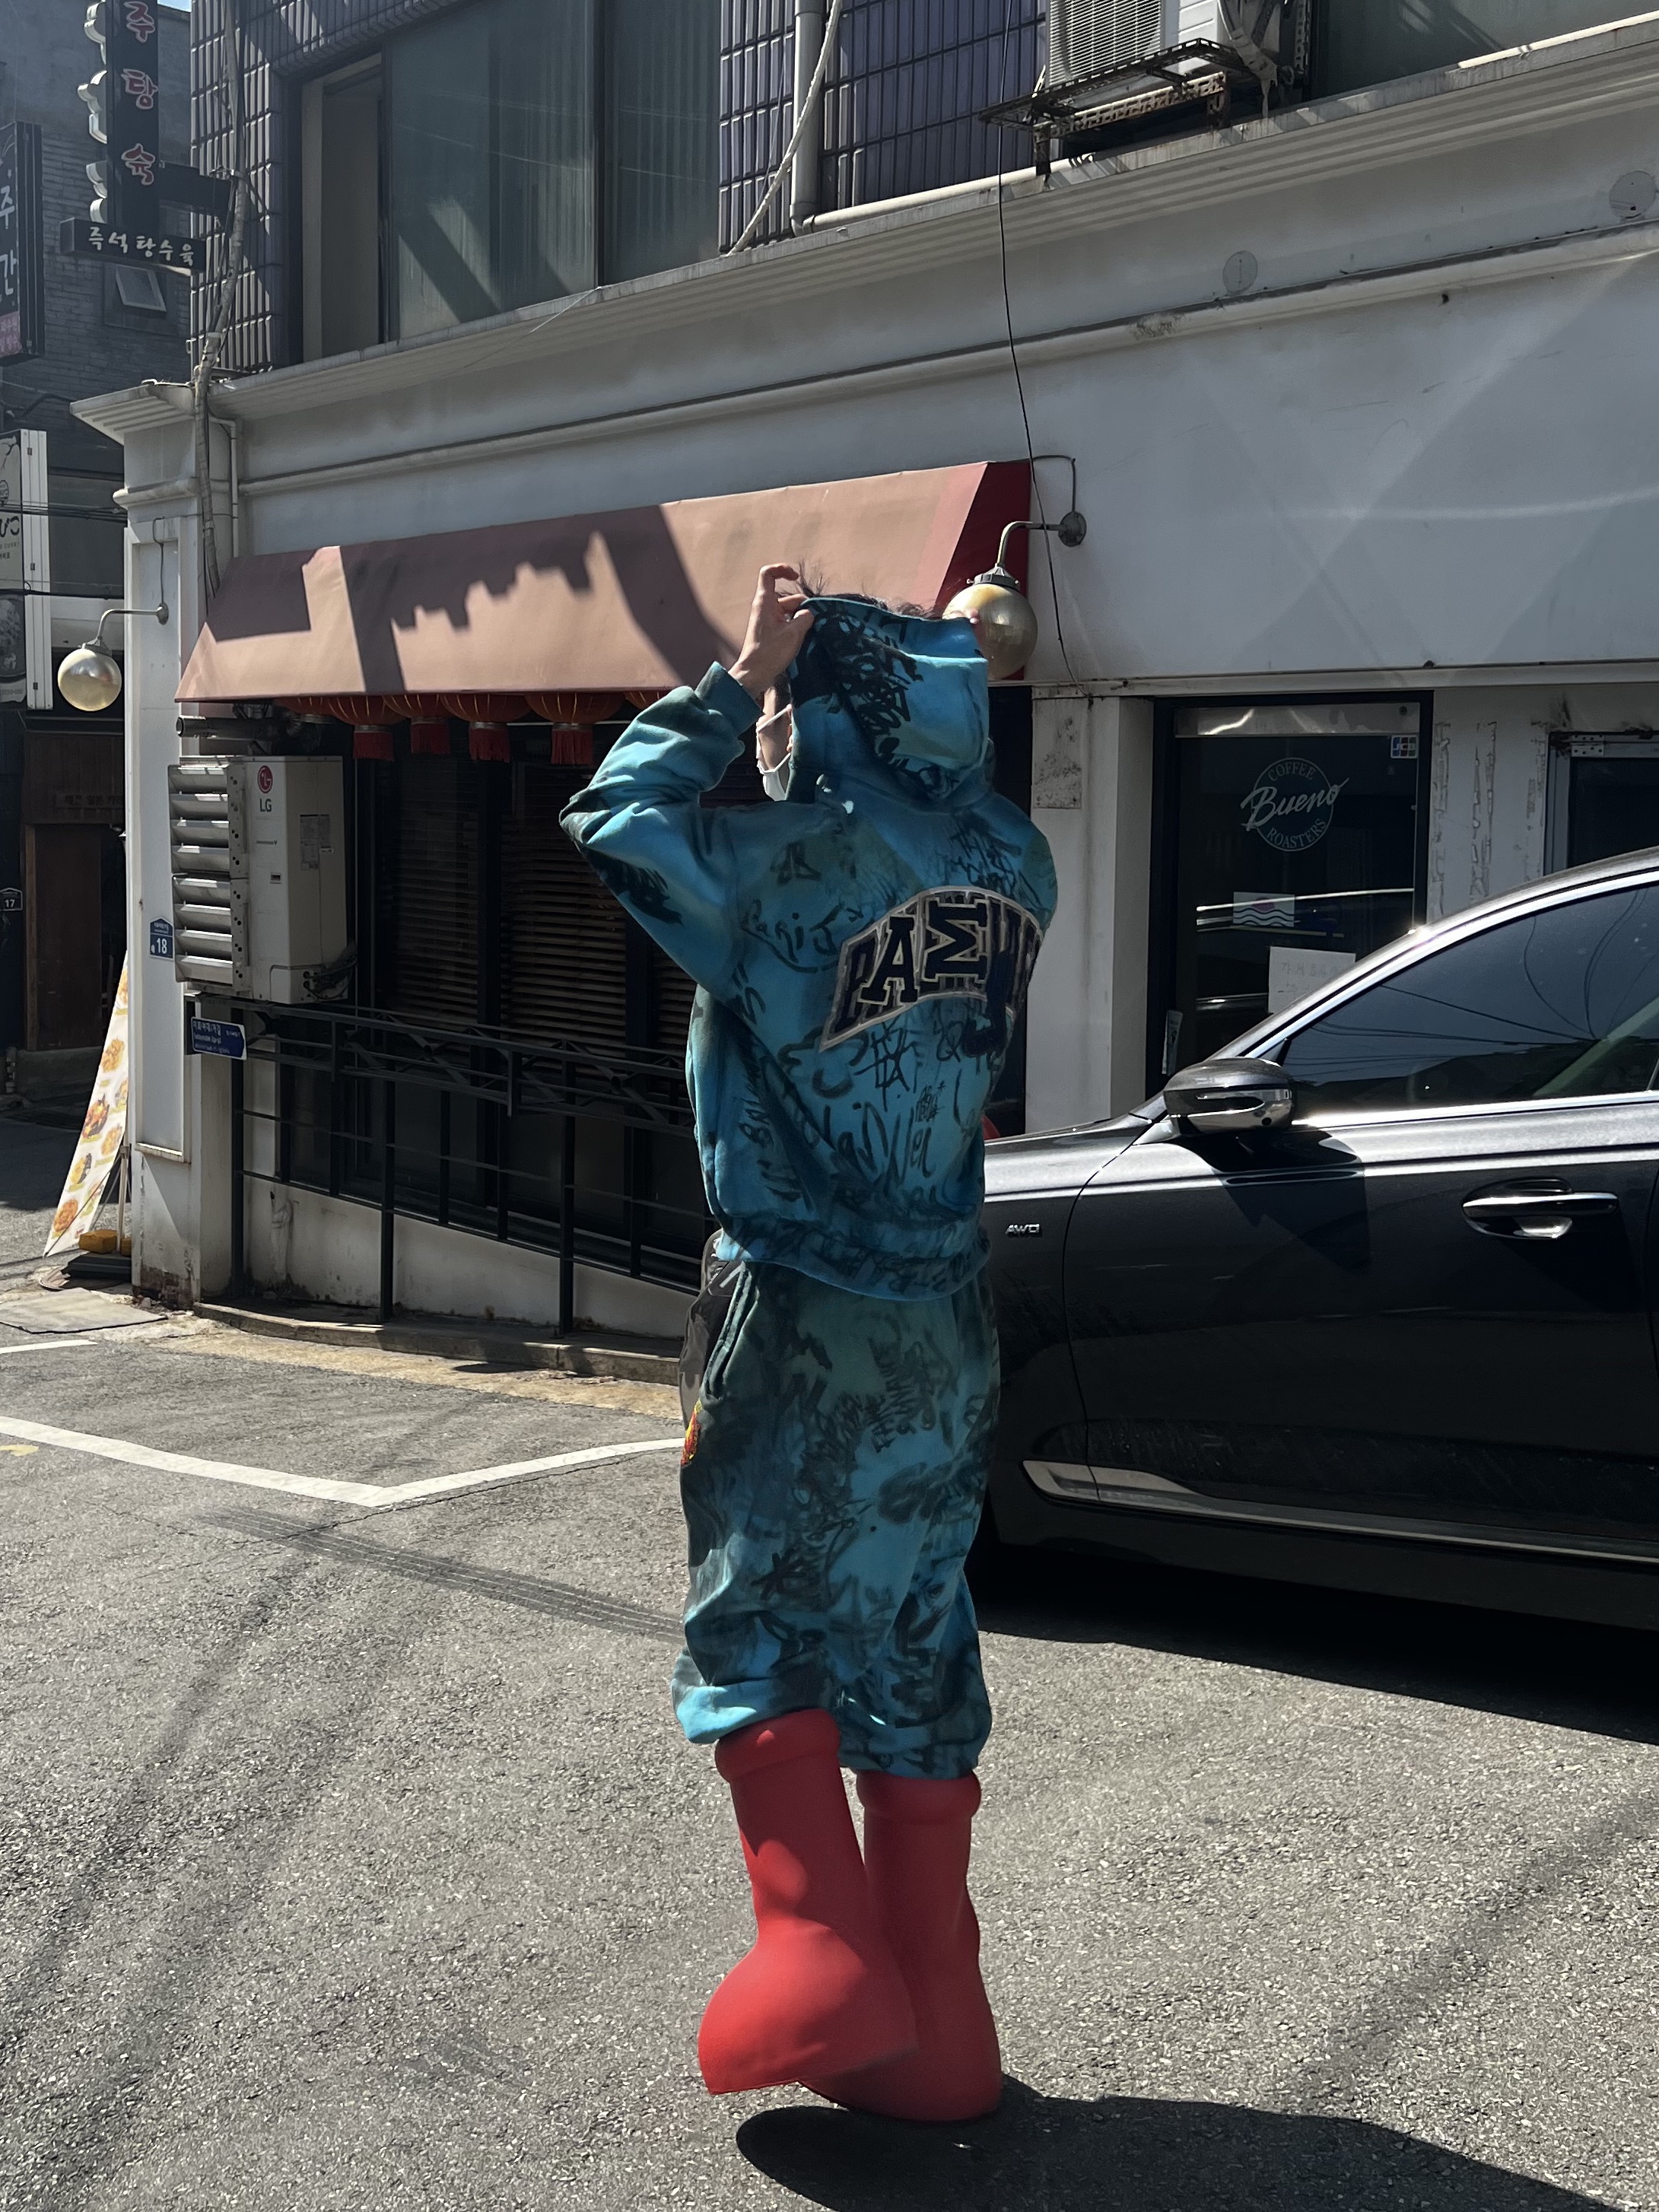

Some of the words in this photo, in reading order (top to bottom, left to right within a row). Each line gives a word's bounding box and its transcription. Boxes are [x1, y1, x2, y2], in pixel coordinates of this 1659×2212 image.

[1268, 761, 1316, 781] COFFEE
[259, 798, 272, 812] LG
[1240, 777, 1350, 832] Bueno
[1266, 818, 1327, 848] ROASTERS
[5, 898, 15, 908] 17
[156, 937, 167, 954] 18
[1005, 1223, 1040, 1235] AWD
